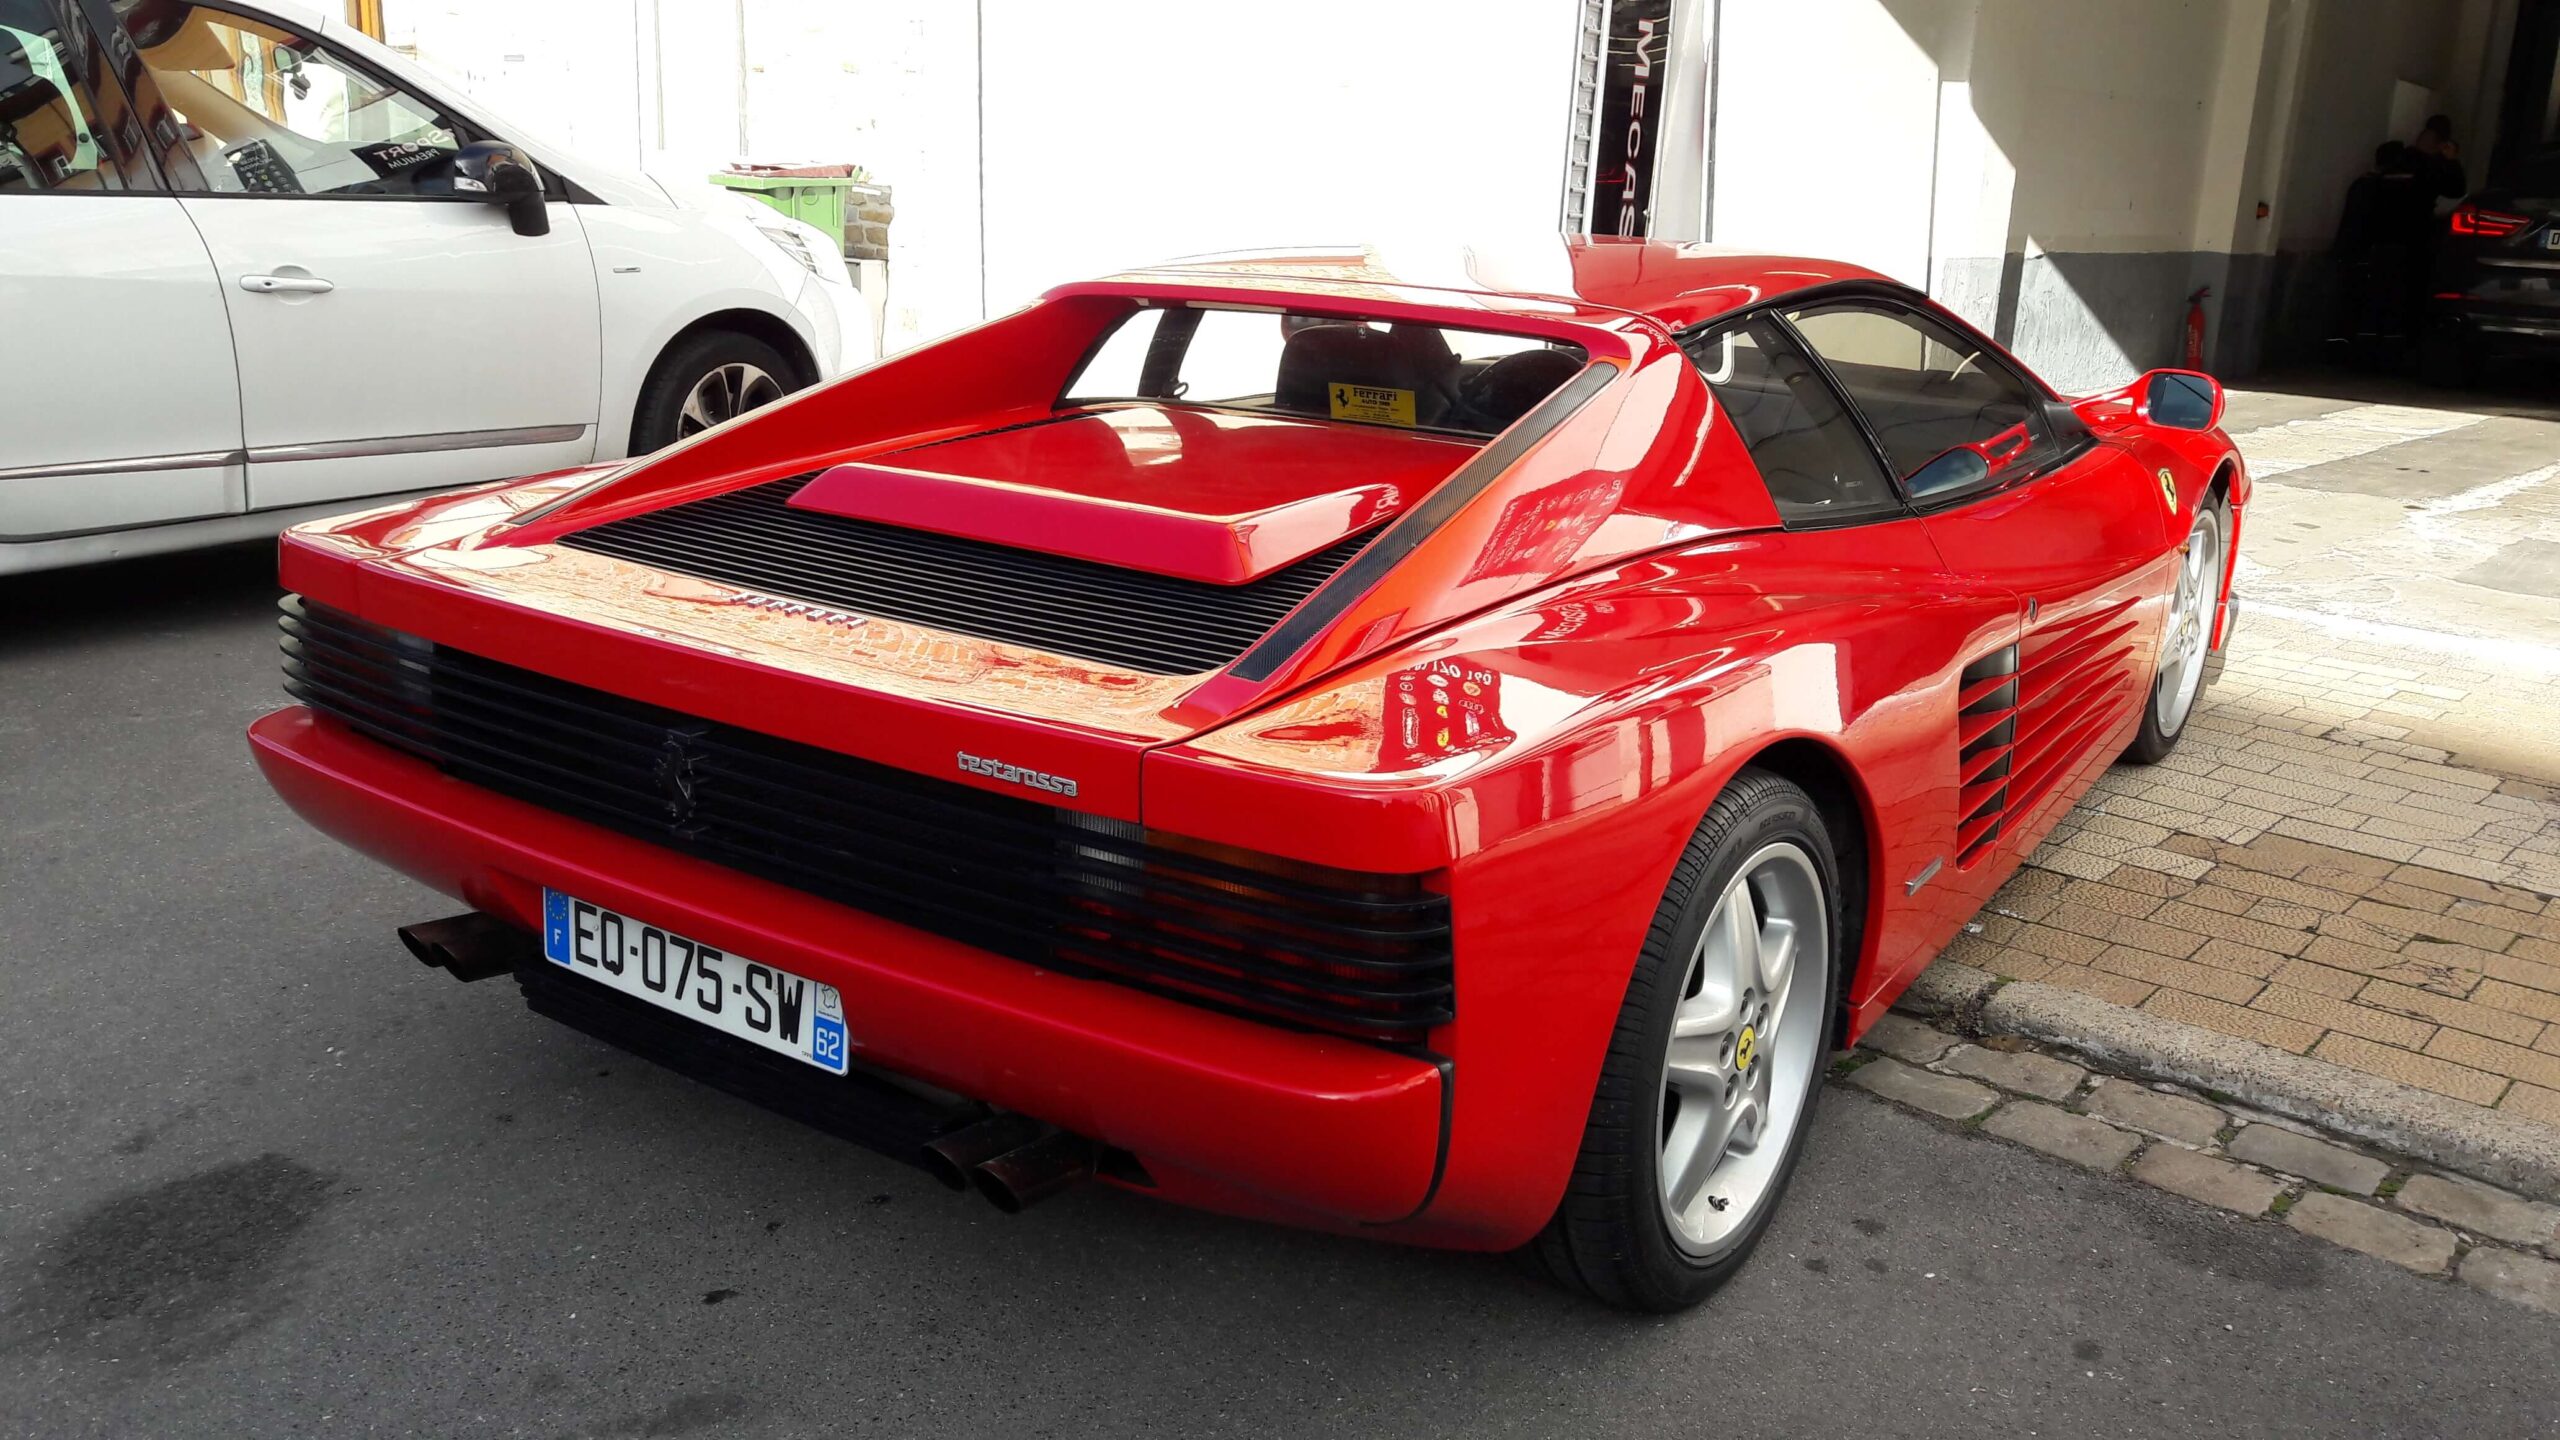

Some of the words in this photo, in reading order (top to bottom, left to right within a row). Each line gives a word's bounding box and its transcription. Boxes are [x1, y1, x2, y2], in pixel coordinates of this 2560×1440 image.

[1618, 18, 1654, 237] MECAS
[1353, 387, 1397, 401] Ferrari
[957, 751, 1078, 797] testarossa
[553, 928, 562, 945] F
[816, 1027, 840, 1061] 62
